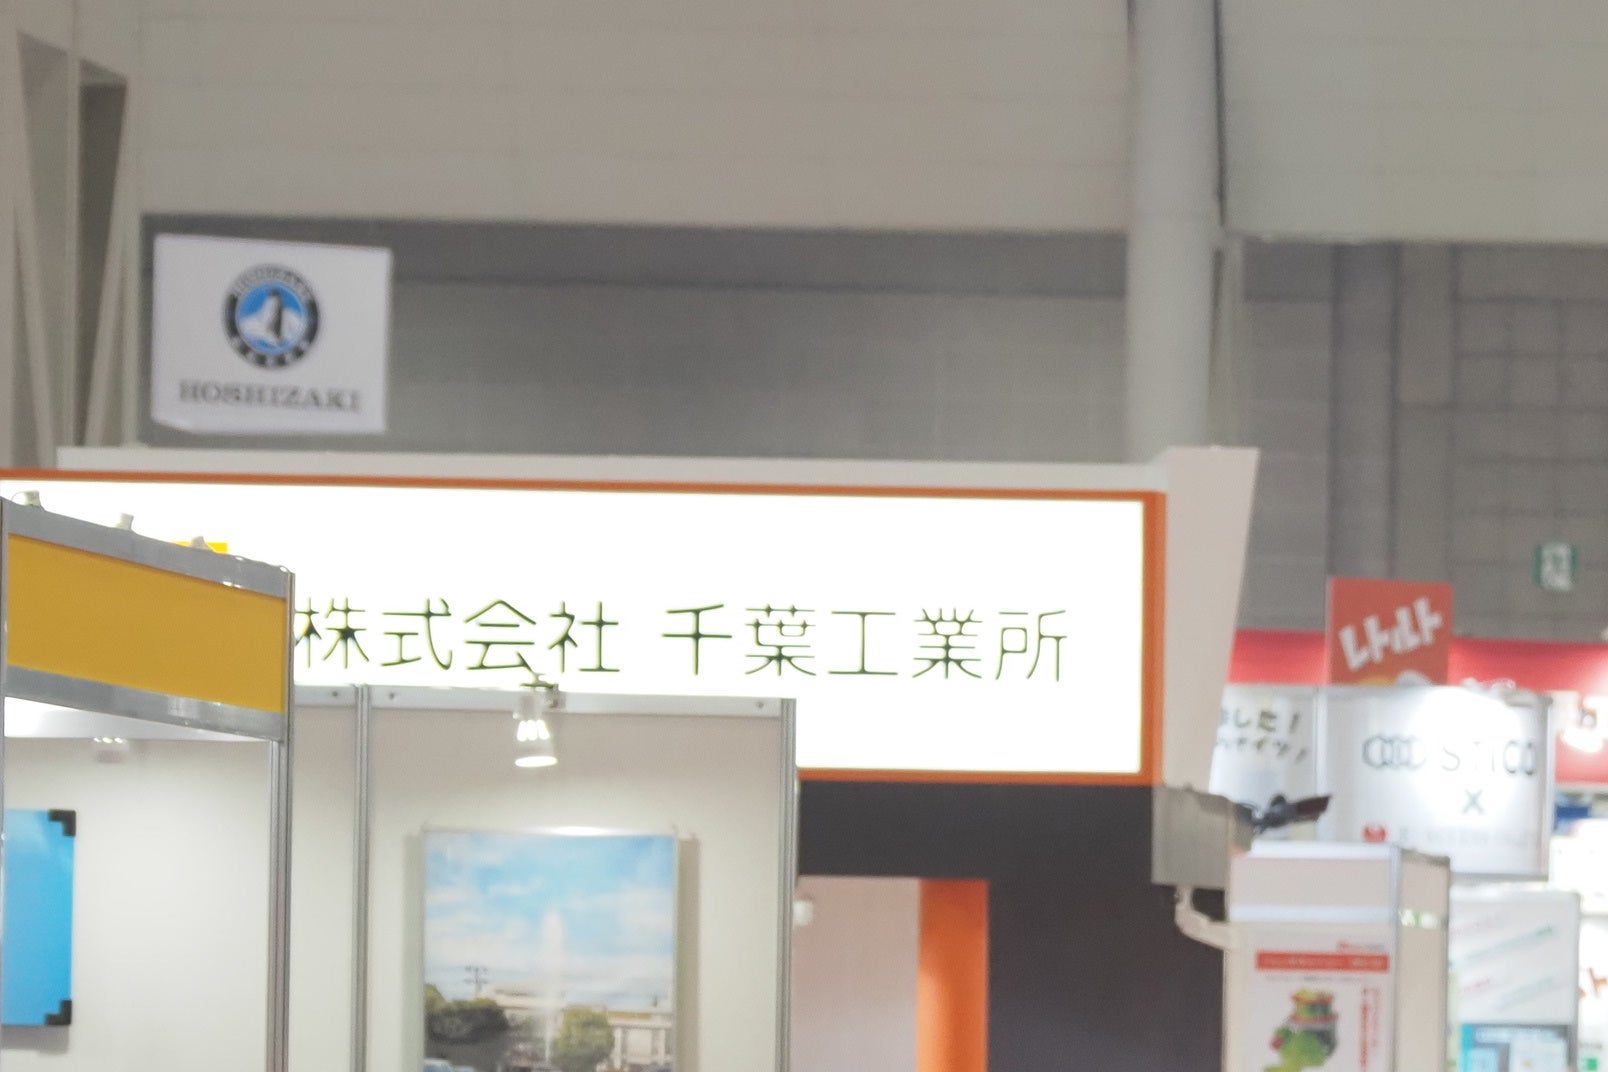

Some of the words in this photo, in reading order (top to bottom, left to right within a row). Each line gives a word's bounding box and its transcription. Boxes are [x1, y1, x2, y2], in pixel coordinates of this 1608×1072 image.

[179, 380, 363, 415] HOSHIZAKI
[295, 597, 622, 674] 株式会社
[662, 603, 1070, 683] 千葉工業所
